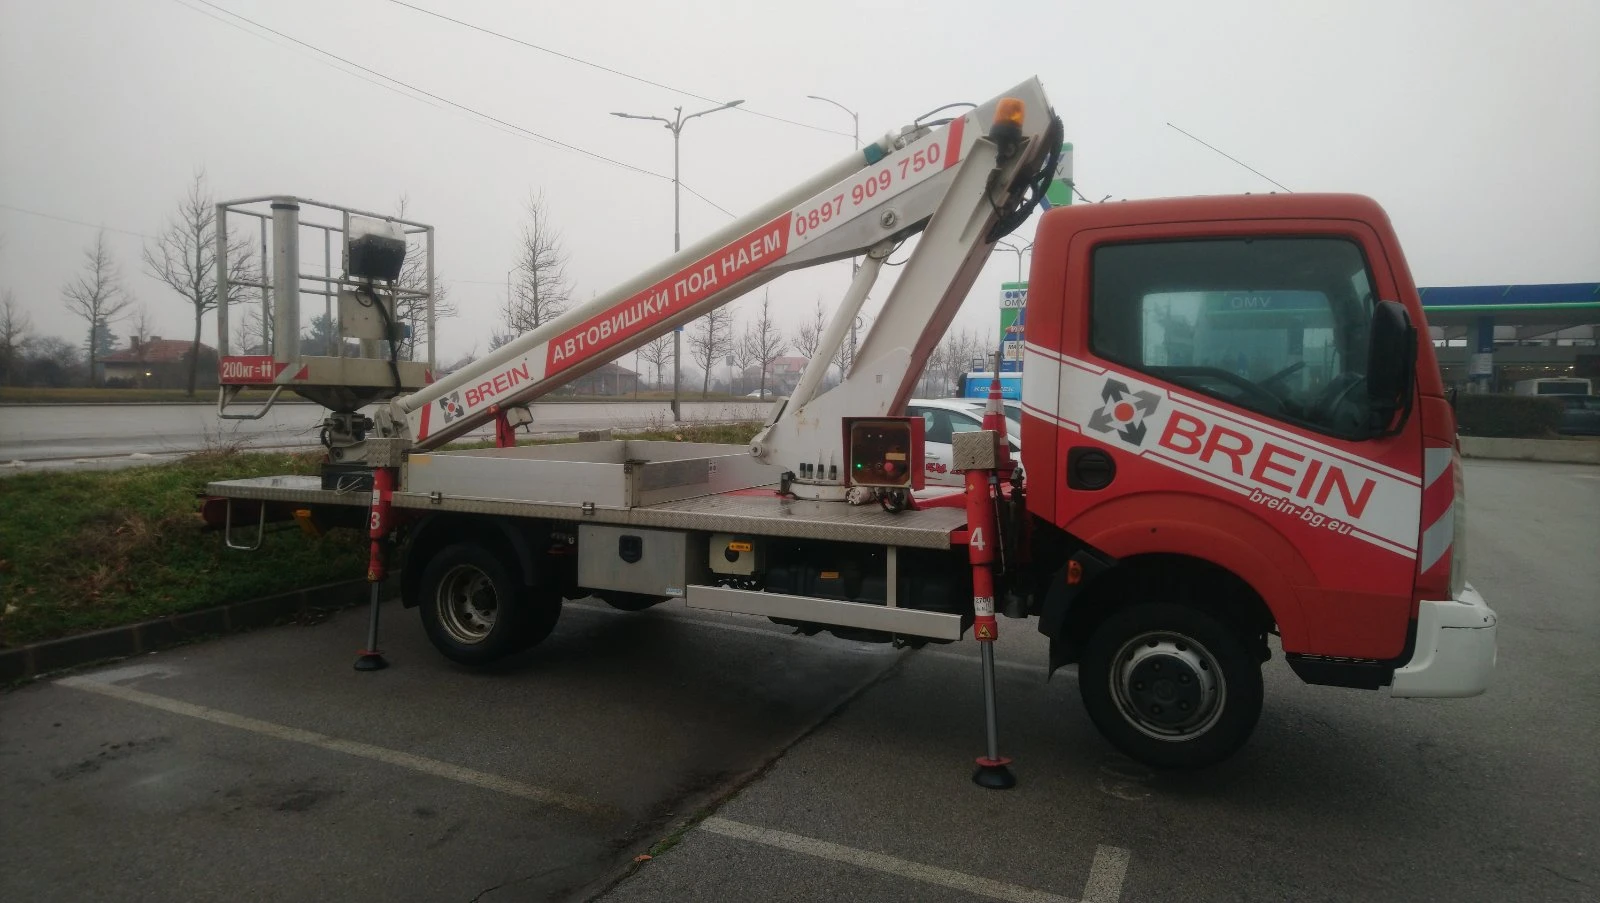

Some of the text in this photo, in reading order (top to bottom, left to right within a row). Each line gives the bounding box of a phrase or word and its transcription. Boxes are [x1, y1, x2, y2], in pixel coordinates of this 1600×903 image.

[553, 142, 940, 364] АВТОВИШКИ ПОД НАЕМ 0897 909 750
[1231, 296, 1272, 308] OMV
[465, 362, 530, 408] BREIN
[1158, 409, 1377, 520] BREIN
[371, 511, 380, 529] 3
[1249, 488, 1352, 536] brein-bg.eu
[970, 527, 985, 551] 4
